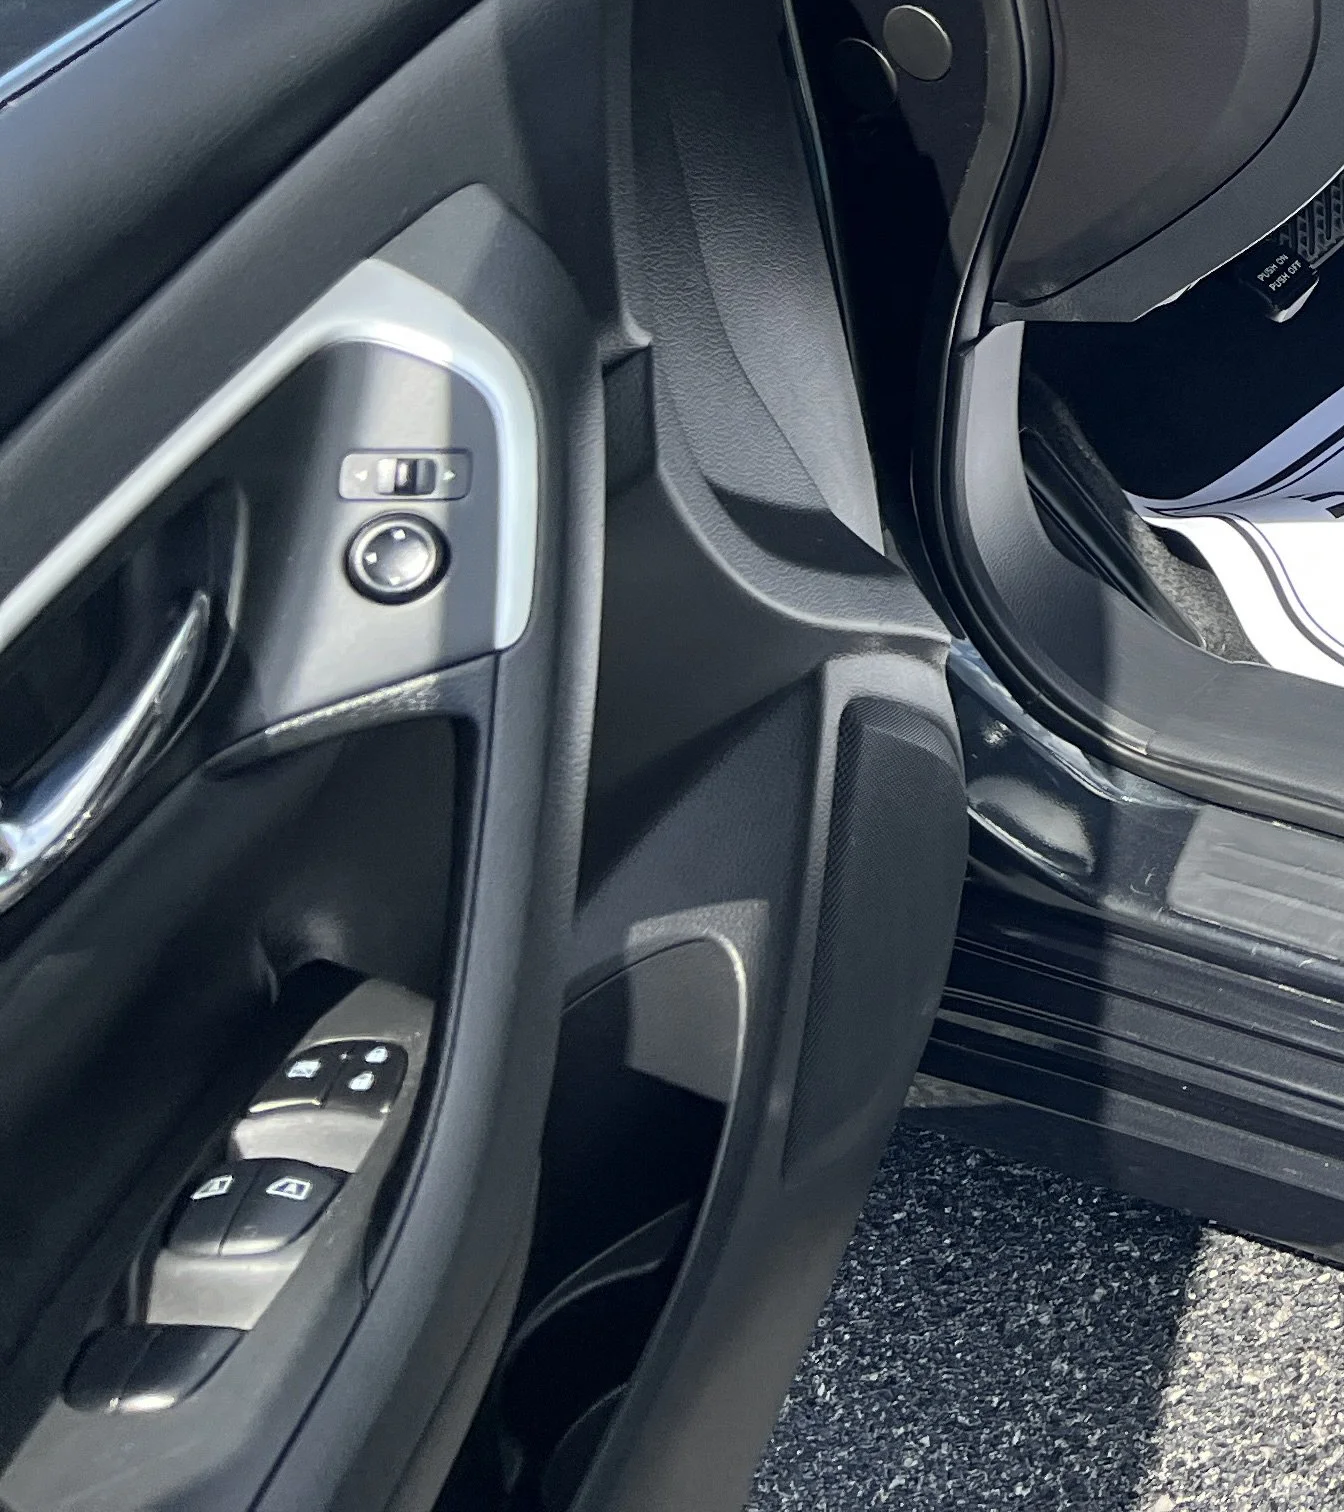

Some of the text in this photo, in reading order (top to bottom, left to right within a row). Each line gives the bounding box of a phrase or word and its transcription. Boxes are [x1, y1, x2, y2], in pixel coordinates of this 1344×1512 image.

[1257, 253, 1289, 281] PUSH ON
[1269, 260, 1301, 291] PUSH OFF
